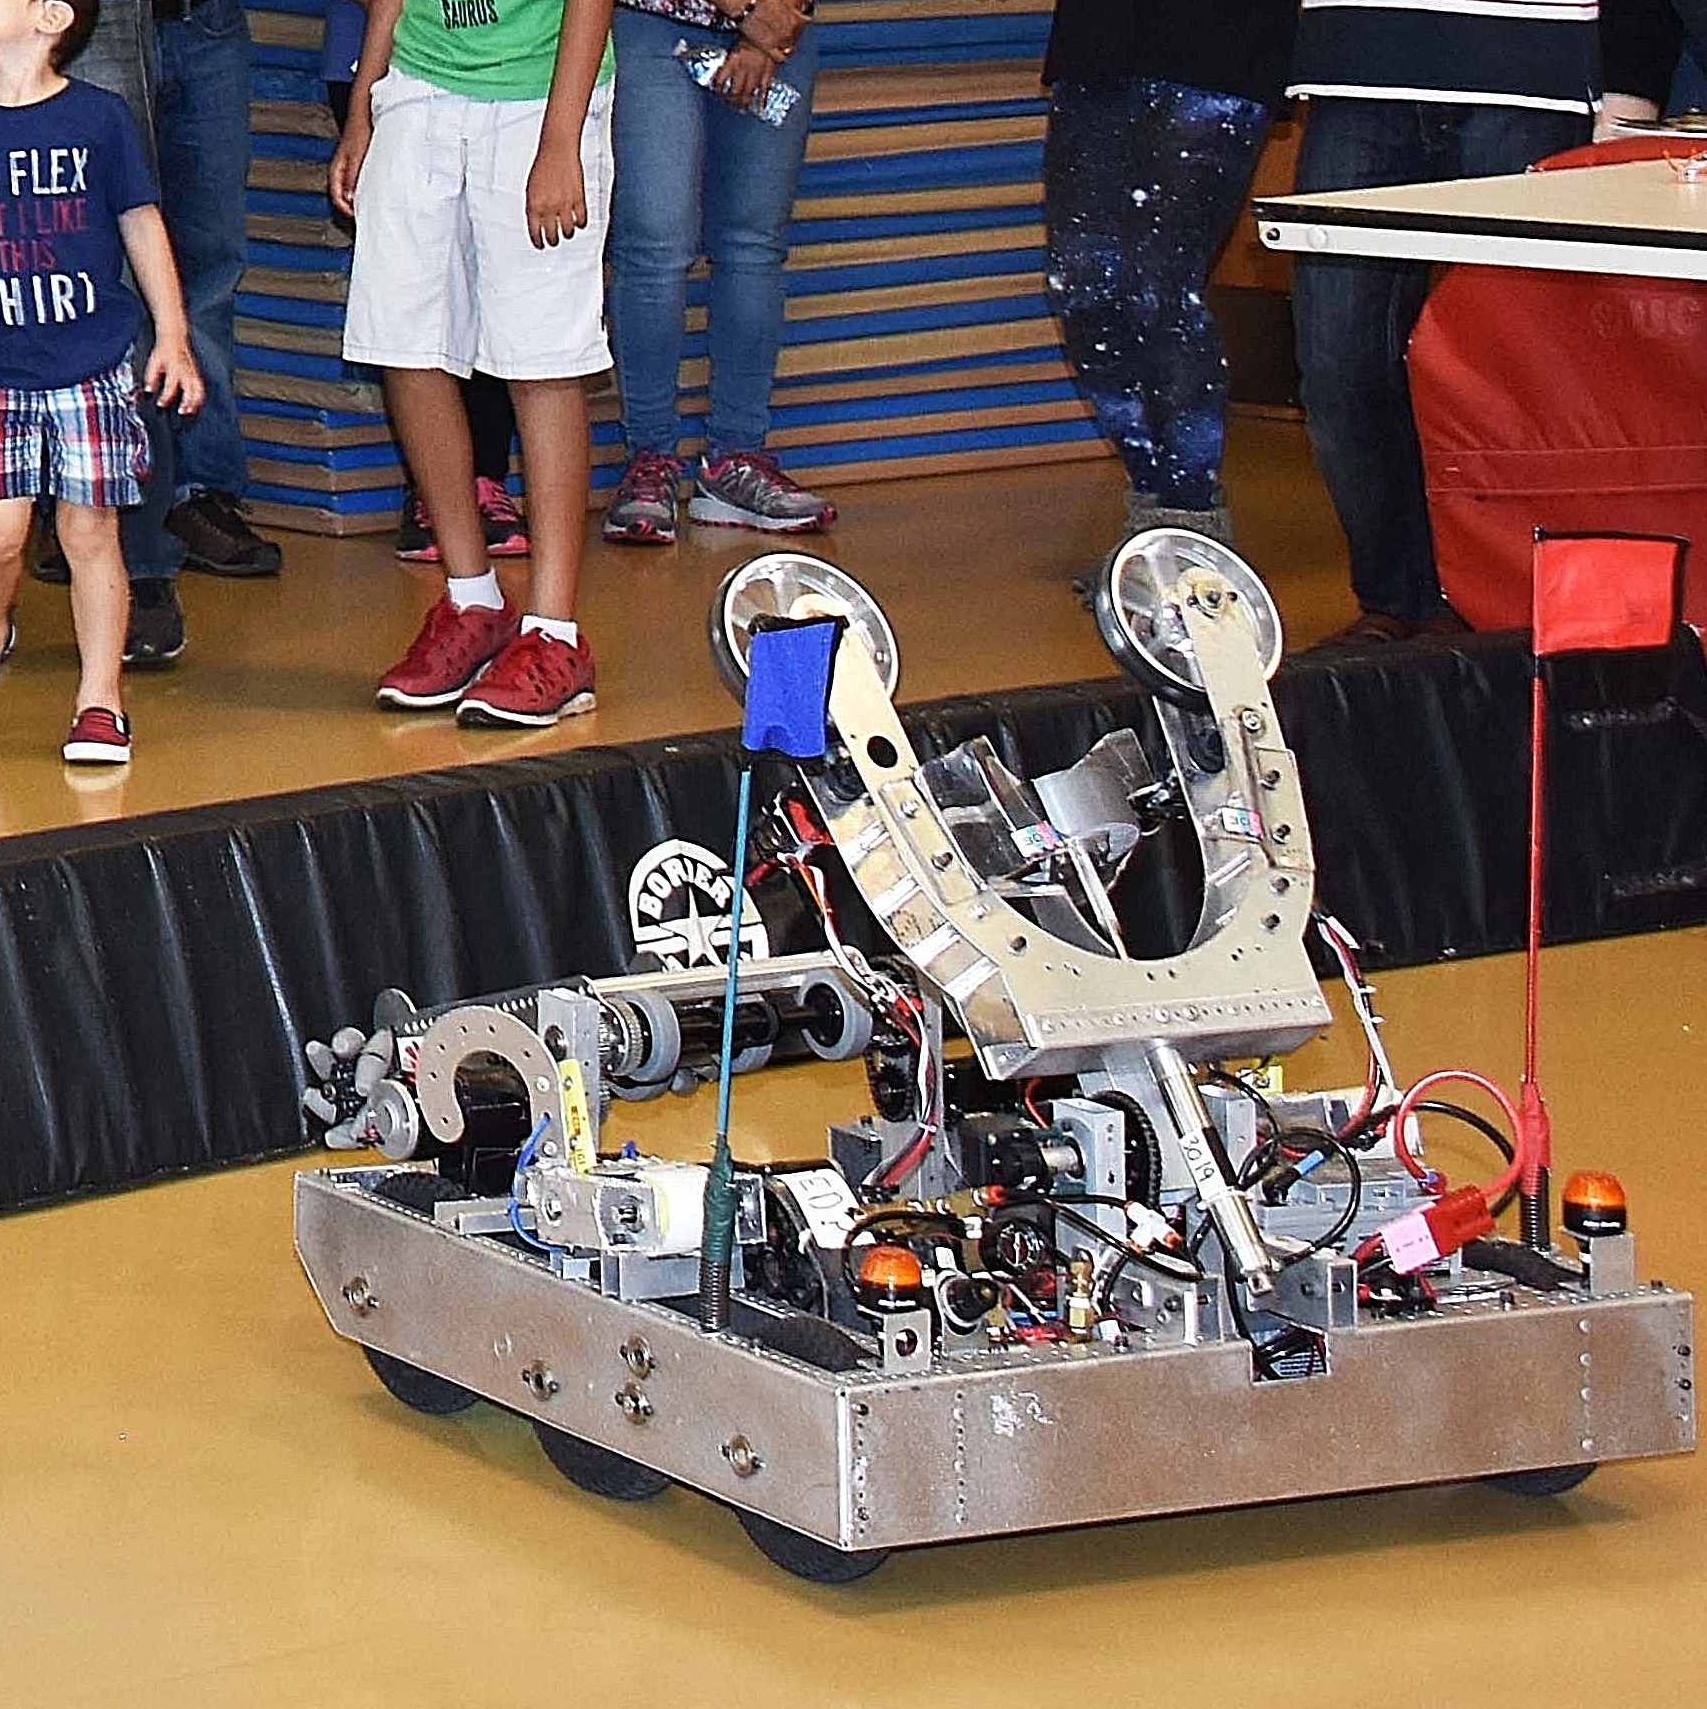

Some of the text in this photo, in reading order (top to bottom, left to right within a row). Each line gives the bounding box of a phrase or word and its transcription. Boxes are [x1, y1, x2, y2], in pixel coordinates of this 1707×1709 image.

[9, 147, 88, 196] FLEX
[35, 197, 88, 235] LIKE
[1182, 1135, 1215, 1183] 3019
